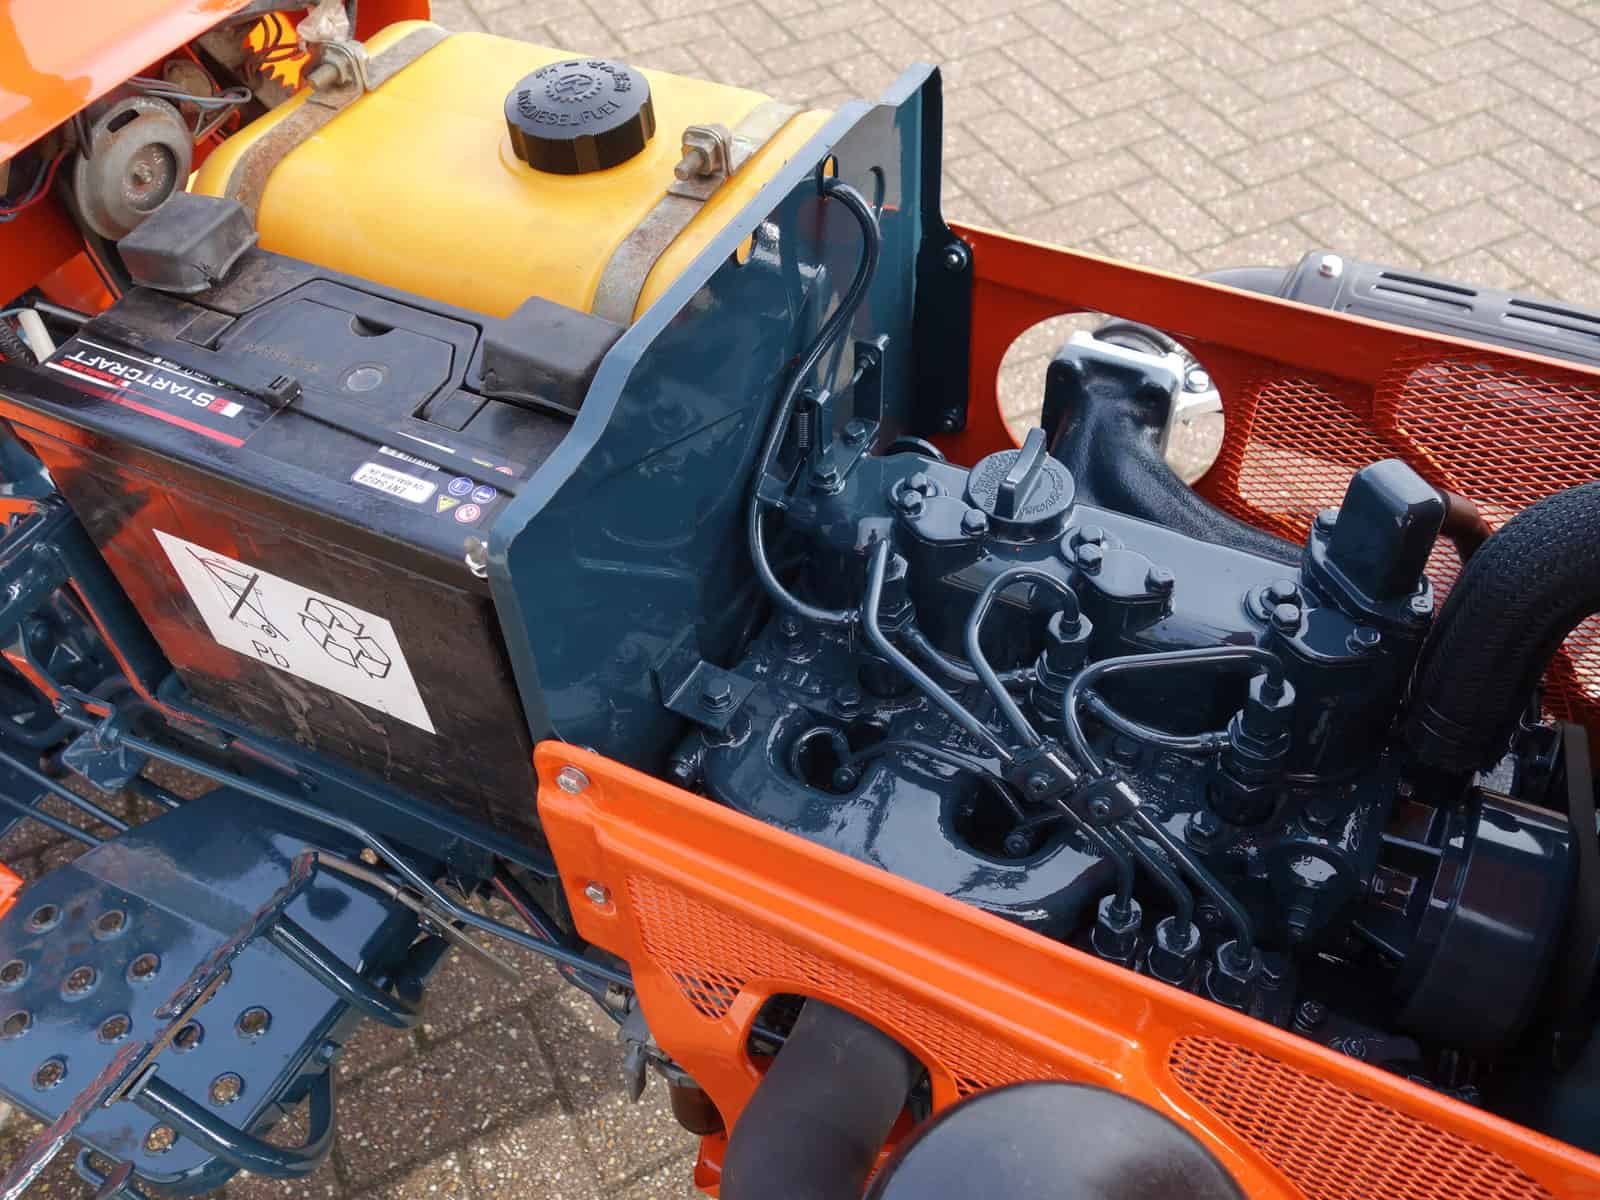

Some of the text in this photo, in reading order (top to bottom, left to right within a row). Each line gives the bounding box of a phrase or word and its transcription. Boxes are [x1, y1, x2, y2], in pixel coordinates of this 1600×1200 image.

[580, 100, 621, 123] FUEL
[64, 350, 216, 408] STARTCRAFT
[251, 639, 291, 669] Pb
